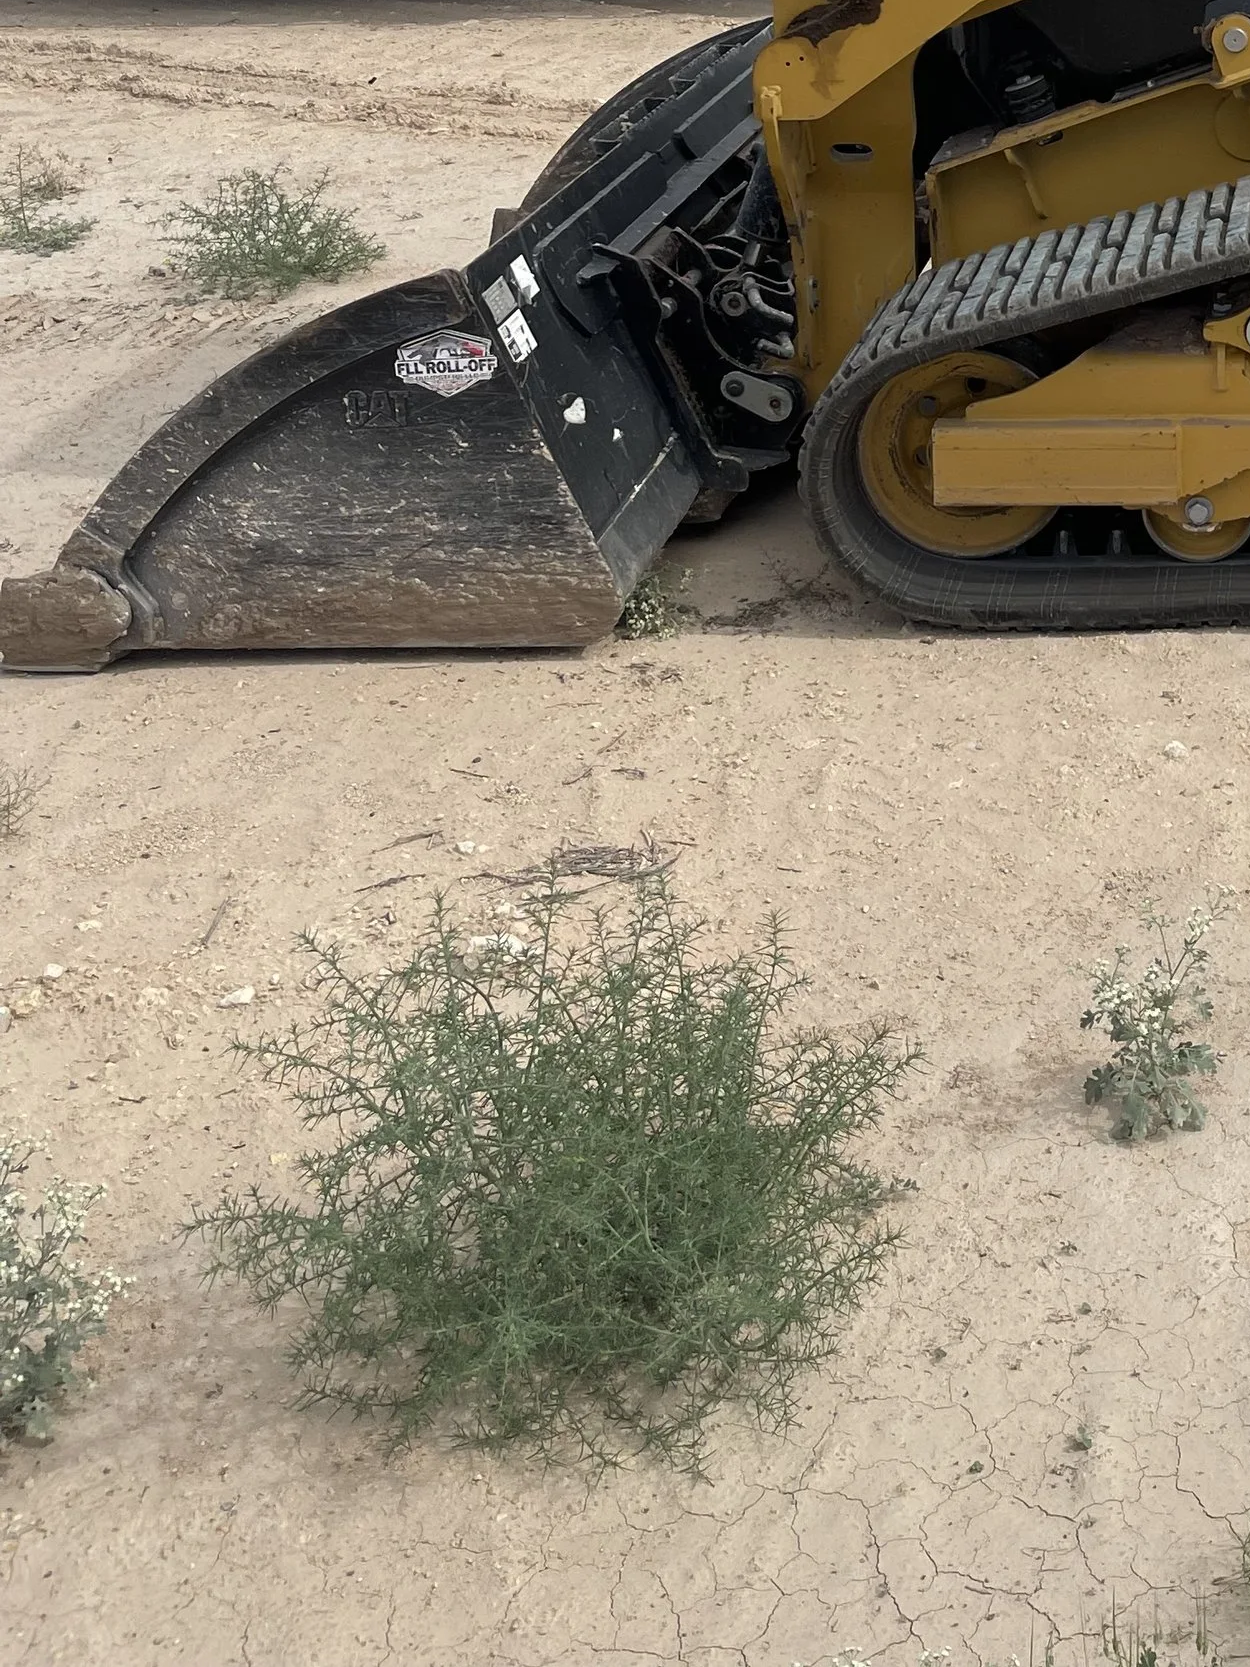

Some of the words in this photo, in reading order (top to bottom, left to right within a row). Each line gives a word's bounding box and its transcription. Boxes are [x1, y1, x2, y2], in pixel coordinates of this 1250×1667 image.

[397, 362, 423, 375] FLL
[425, 358, 496, 374] ROLL-OFF
[343, 389, 409, 427] CAT
